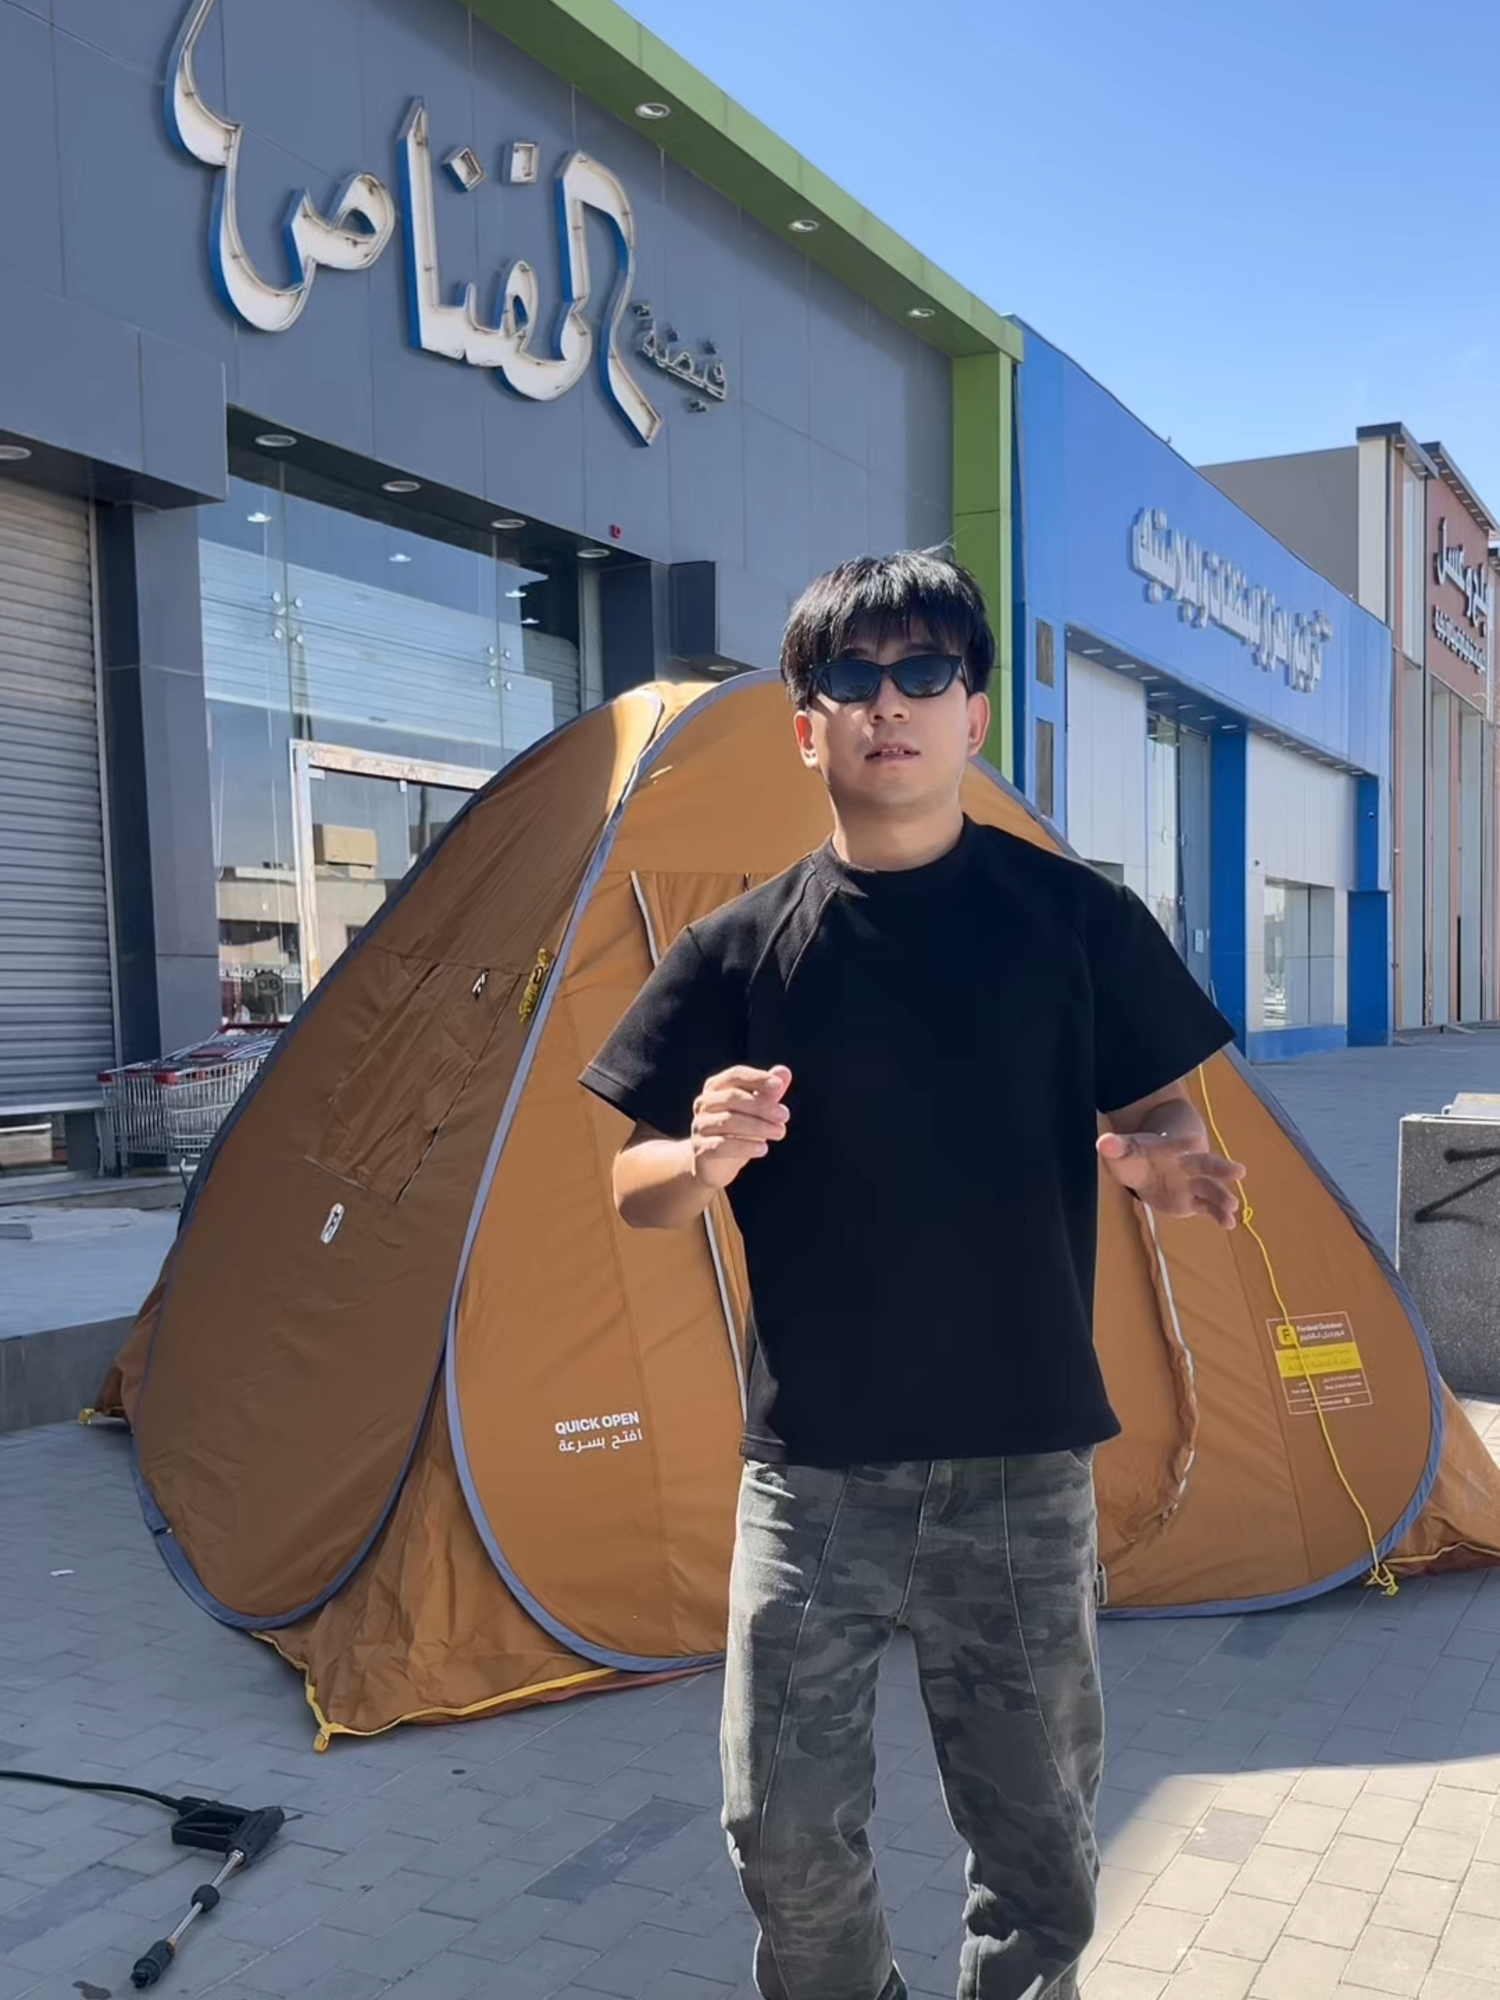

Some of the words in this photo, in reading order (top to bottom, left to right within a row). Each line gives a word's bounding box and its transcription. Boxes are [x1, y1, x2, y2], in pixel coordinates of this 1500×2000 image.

[555, 1416, 600, 1435] QUICK
[601, 1411, 640, 1427] OPEN
[558, 1437, 606, 1454] بسرعة
[611, 1428, 643, 1449] افتح
